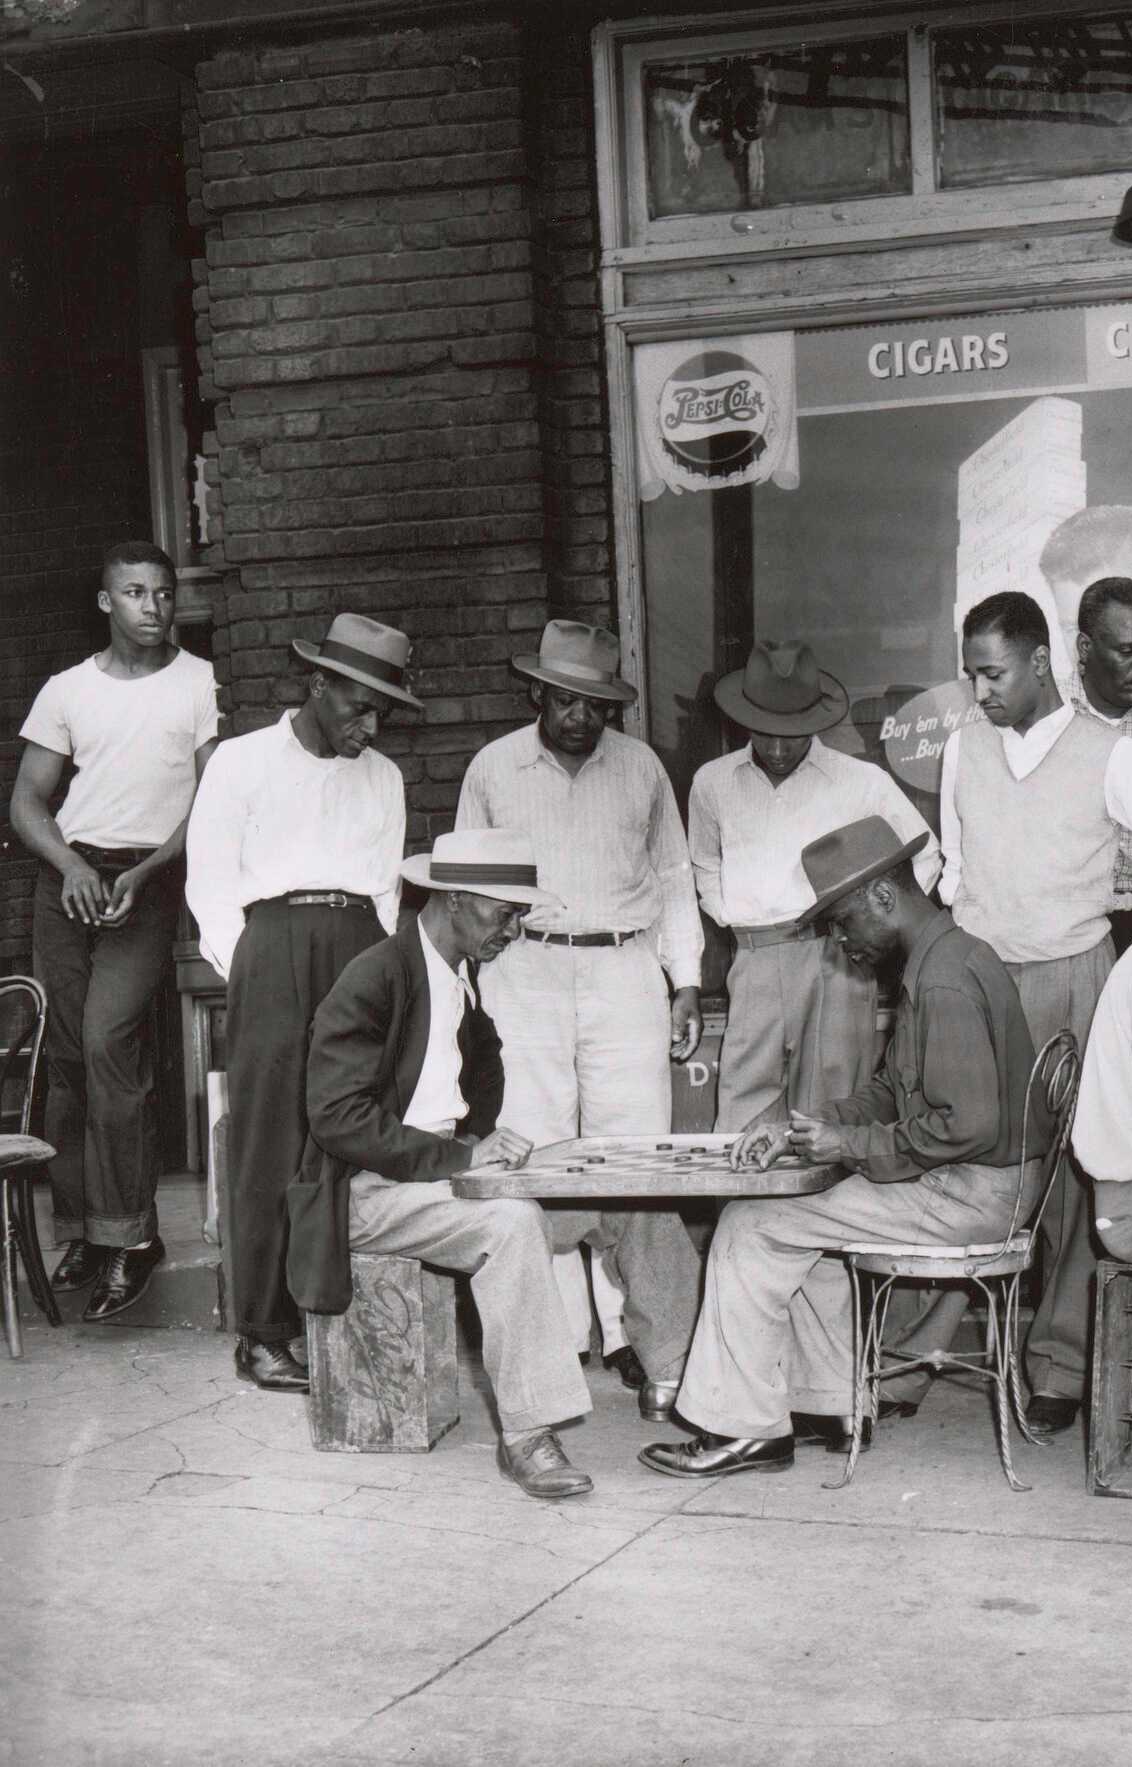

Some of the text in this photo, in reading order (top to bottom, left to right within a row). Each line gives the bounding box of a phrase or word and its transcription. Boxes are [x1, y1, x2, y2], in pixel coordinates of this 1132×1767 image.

[868, 332, 1010, 379] CIGARS
[880, 715, 911, 740] Buy
[943, 708, 961, 731] by
